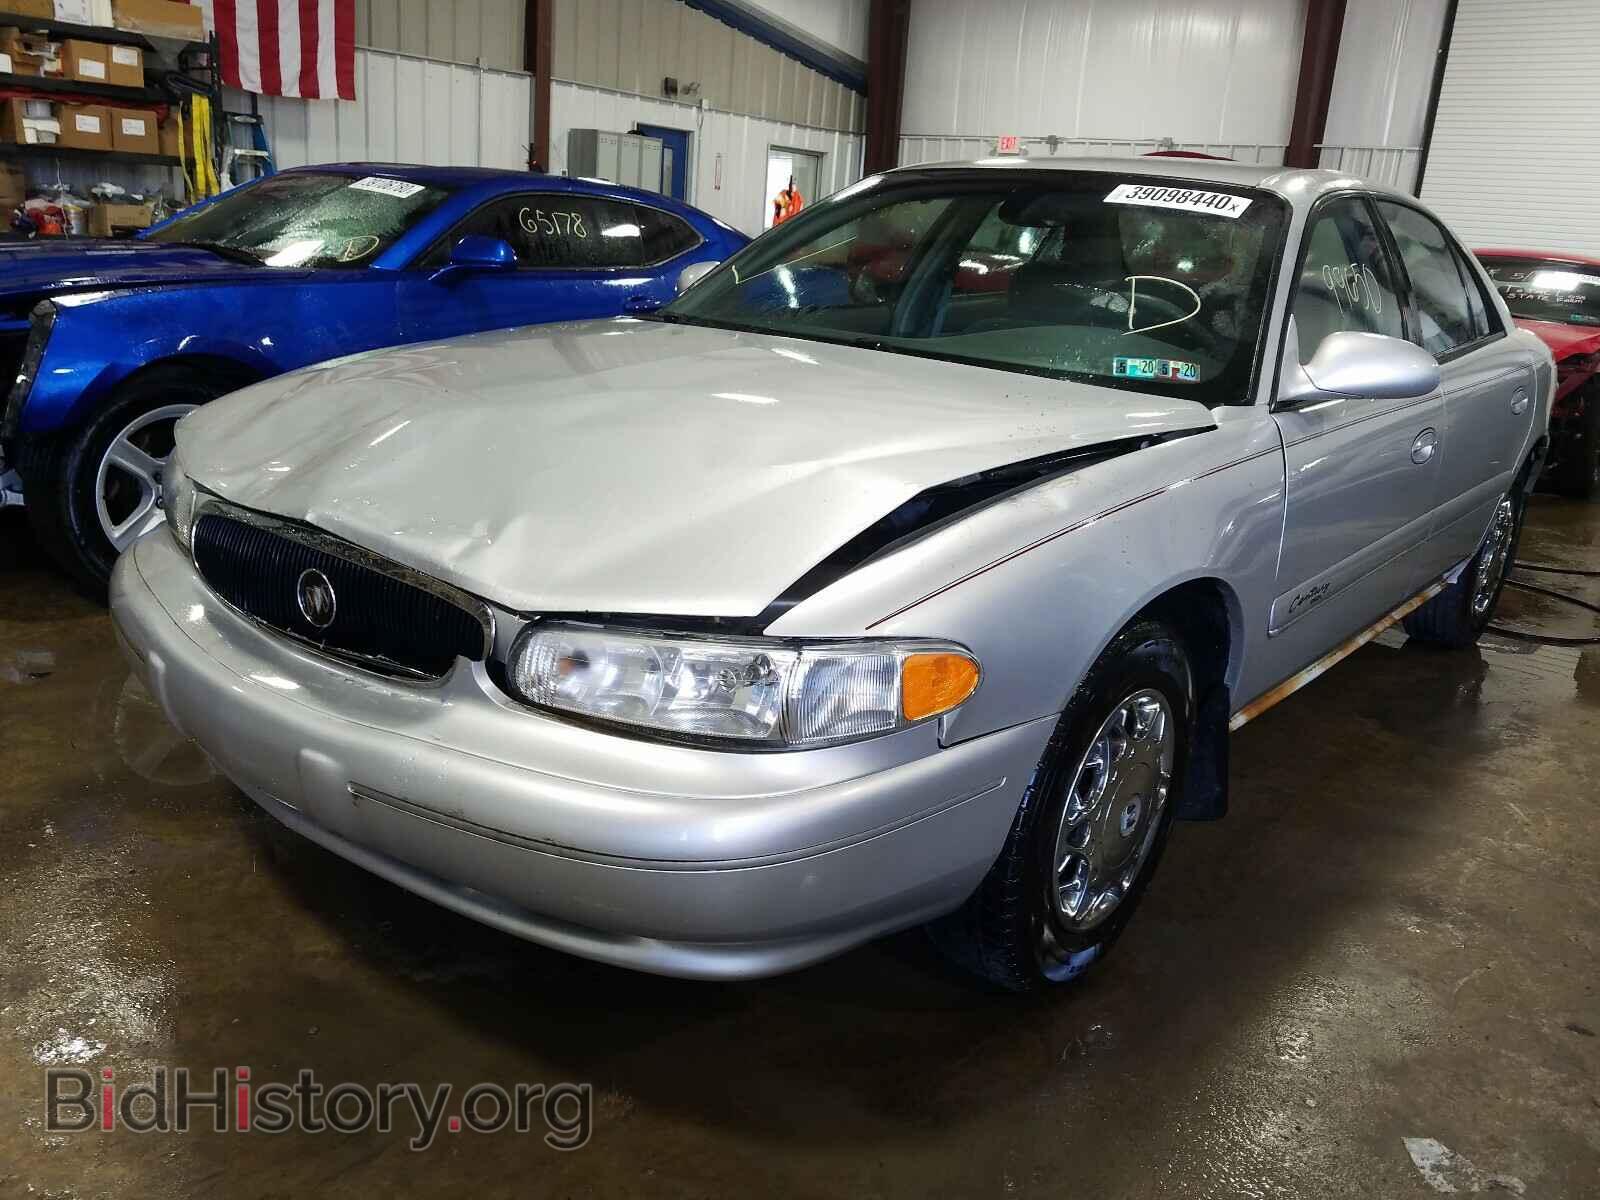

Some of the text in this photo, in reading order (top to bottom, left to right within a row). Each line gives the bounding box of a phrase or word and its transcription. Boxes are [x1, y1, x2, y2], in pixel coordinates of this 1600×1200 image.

[1125, 186, 1232, 210] 39098440
[1121, 275, 1202, 336] D
[1142, 360, 1154, 374] 20
[1184, 363, 1196, 378] 20
